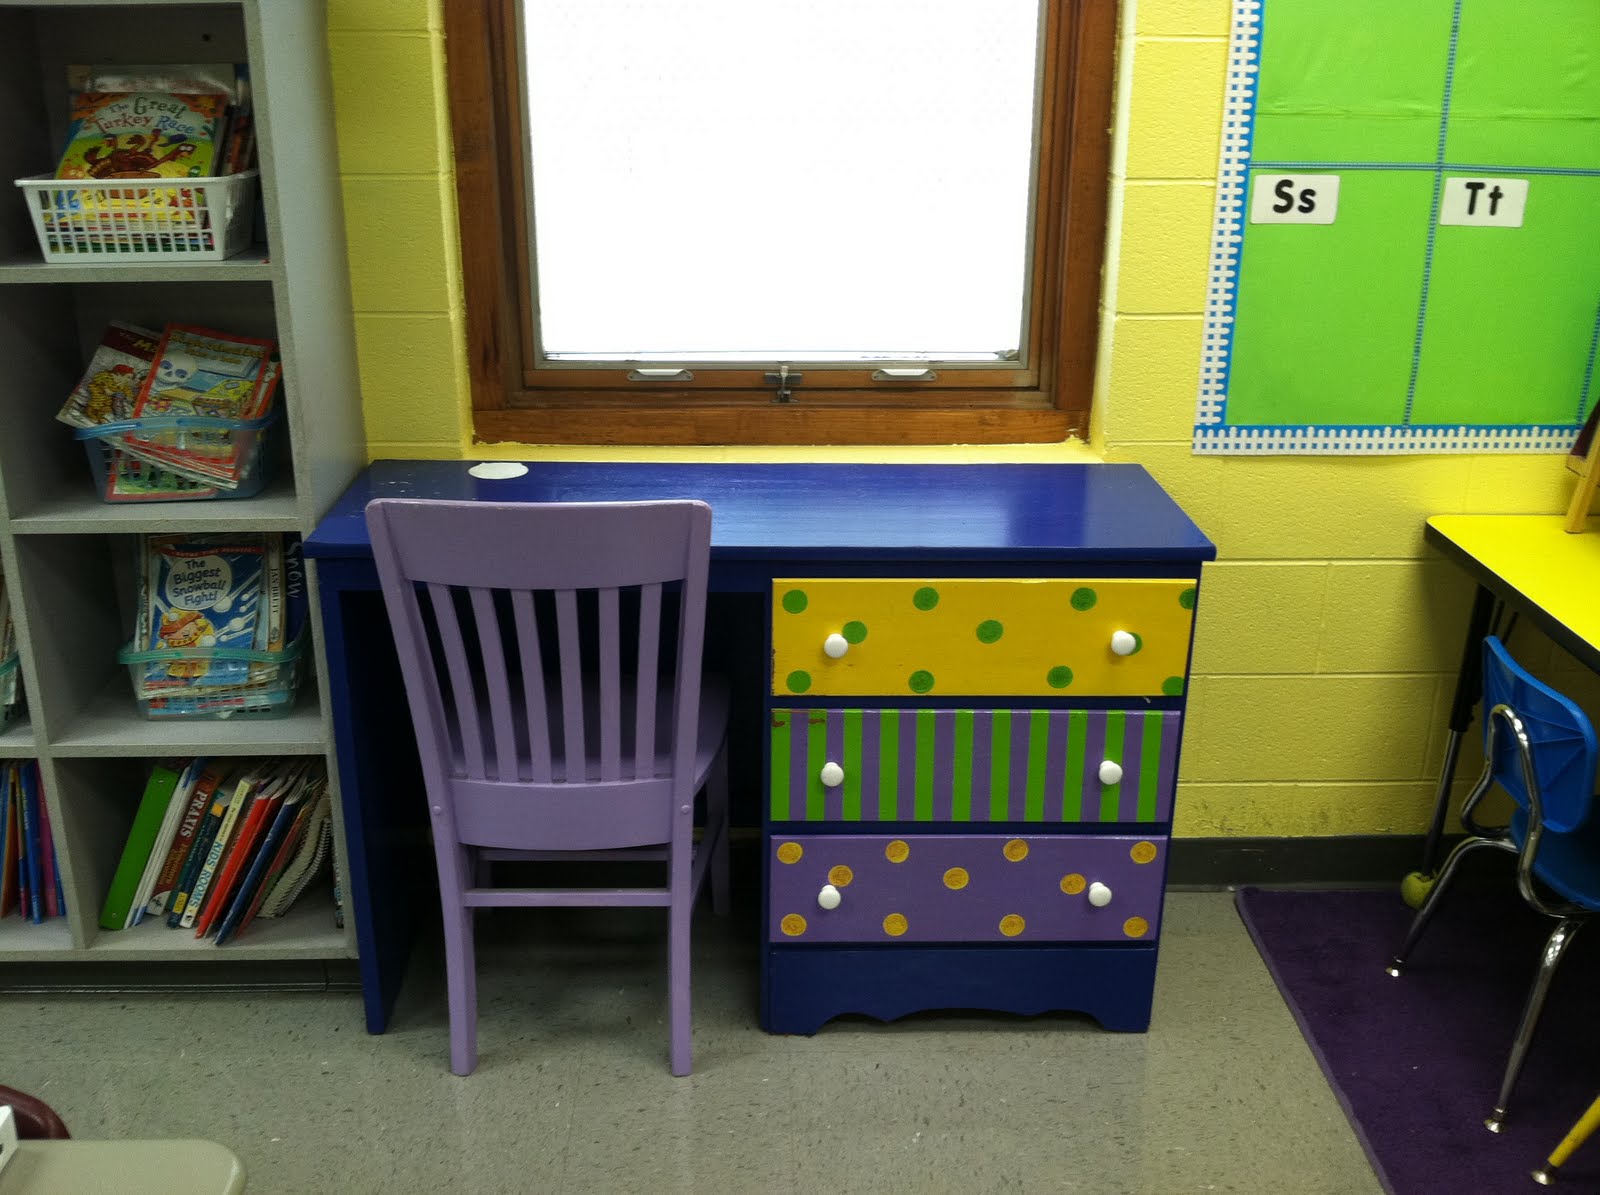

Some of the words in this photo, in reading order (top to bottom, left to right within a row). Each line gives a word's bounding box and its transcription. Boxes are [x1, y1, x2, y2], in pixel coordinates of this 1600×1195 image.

[133, 96, 187, 119] Great
[98, 114, 152, 134] Turkey
[155, 115, 195, 135] Race
[1272, 179, 1316, 214] Ss
[1465, 182, 1503, 216] Tt
[185, 557, 206, 569] The
[173, 567, 221, 585] Biggest
[172, 580, 227, 598] Snowball
[184, 591, 218, 606] Fight!
[181, 790, 208, 838] PRAXIS
[189, 870, 213, 907] ROOMS
